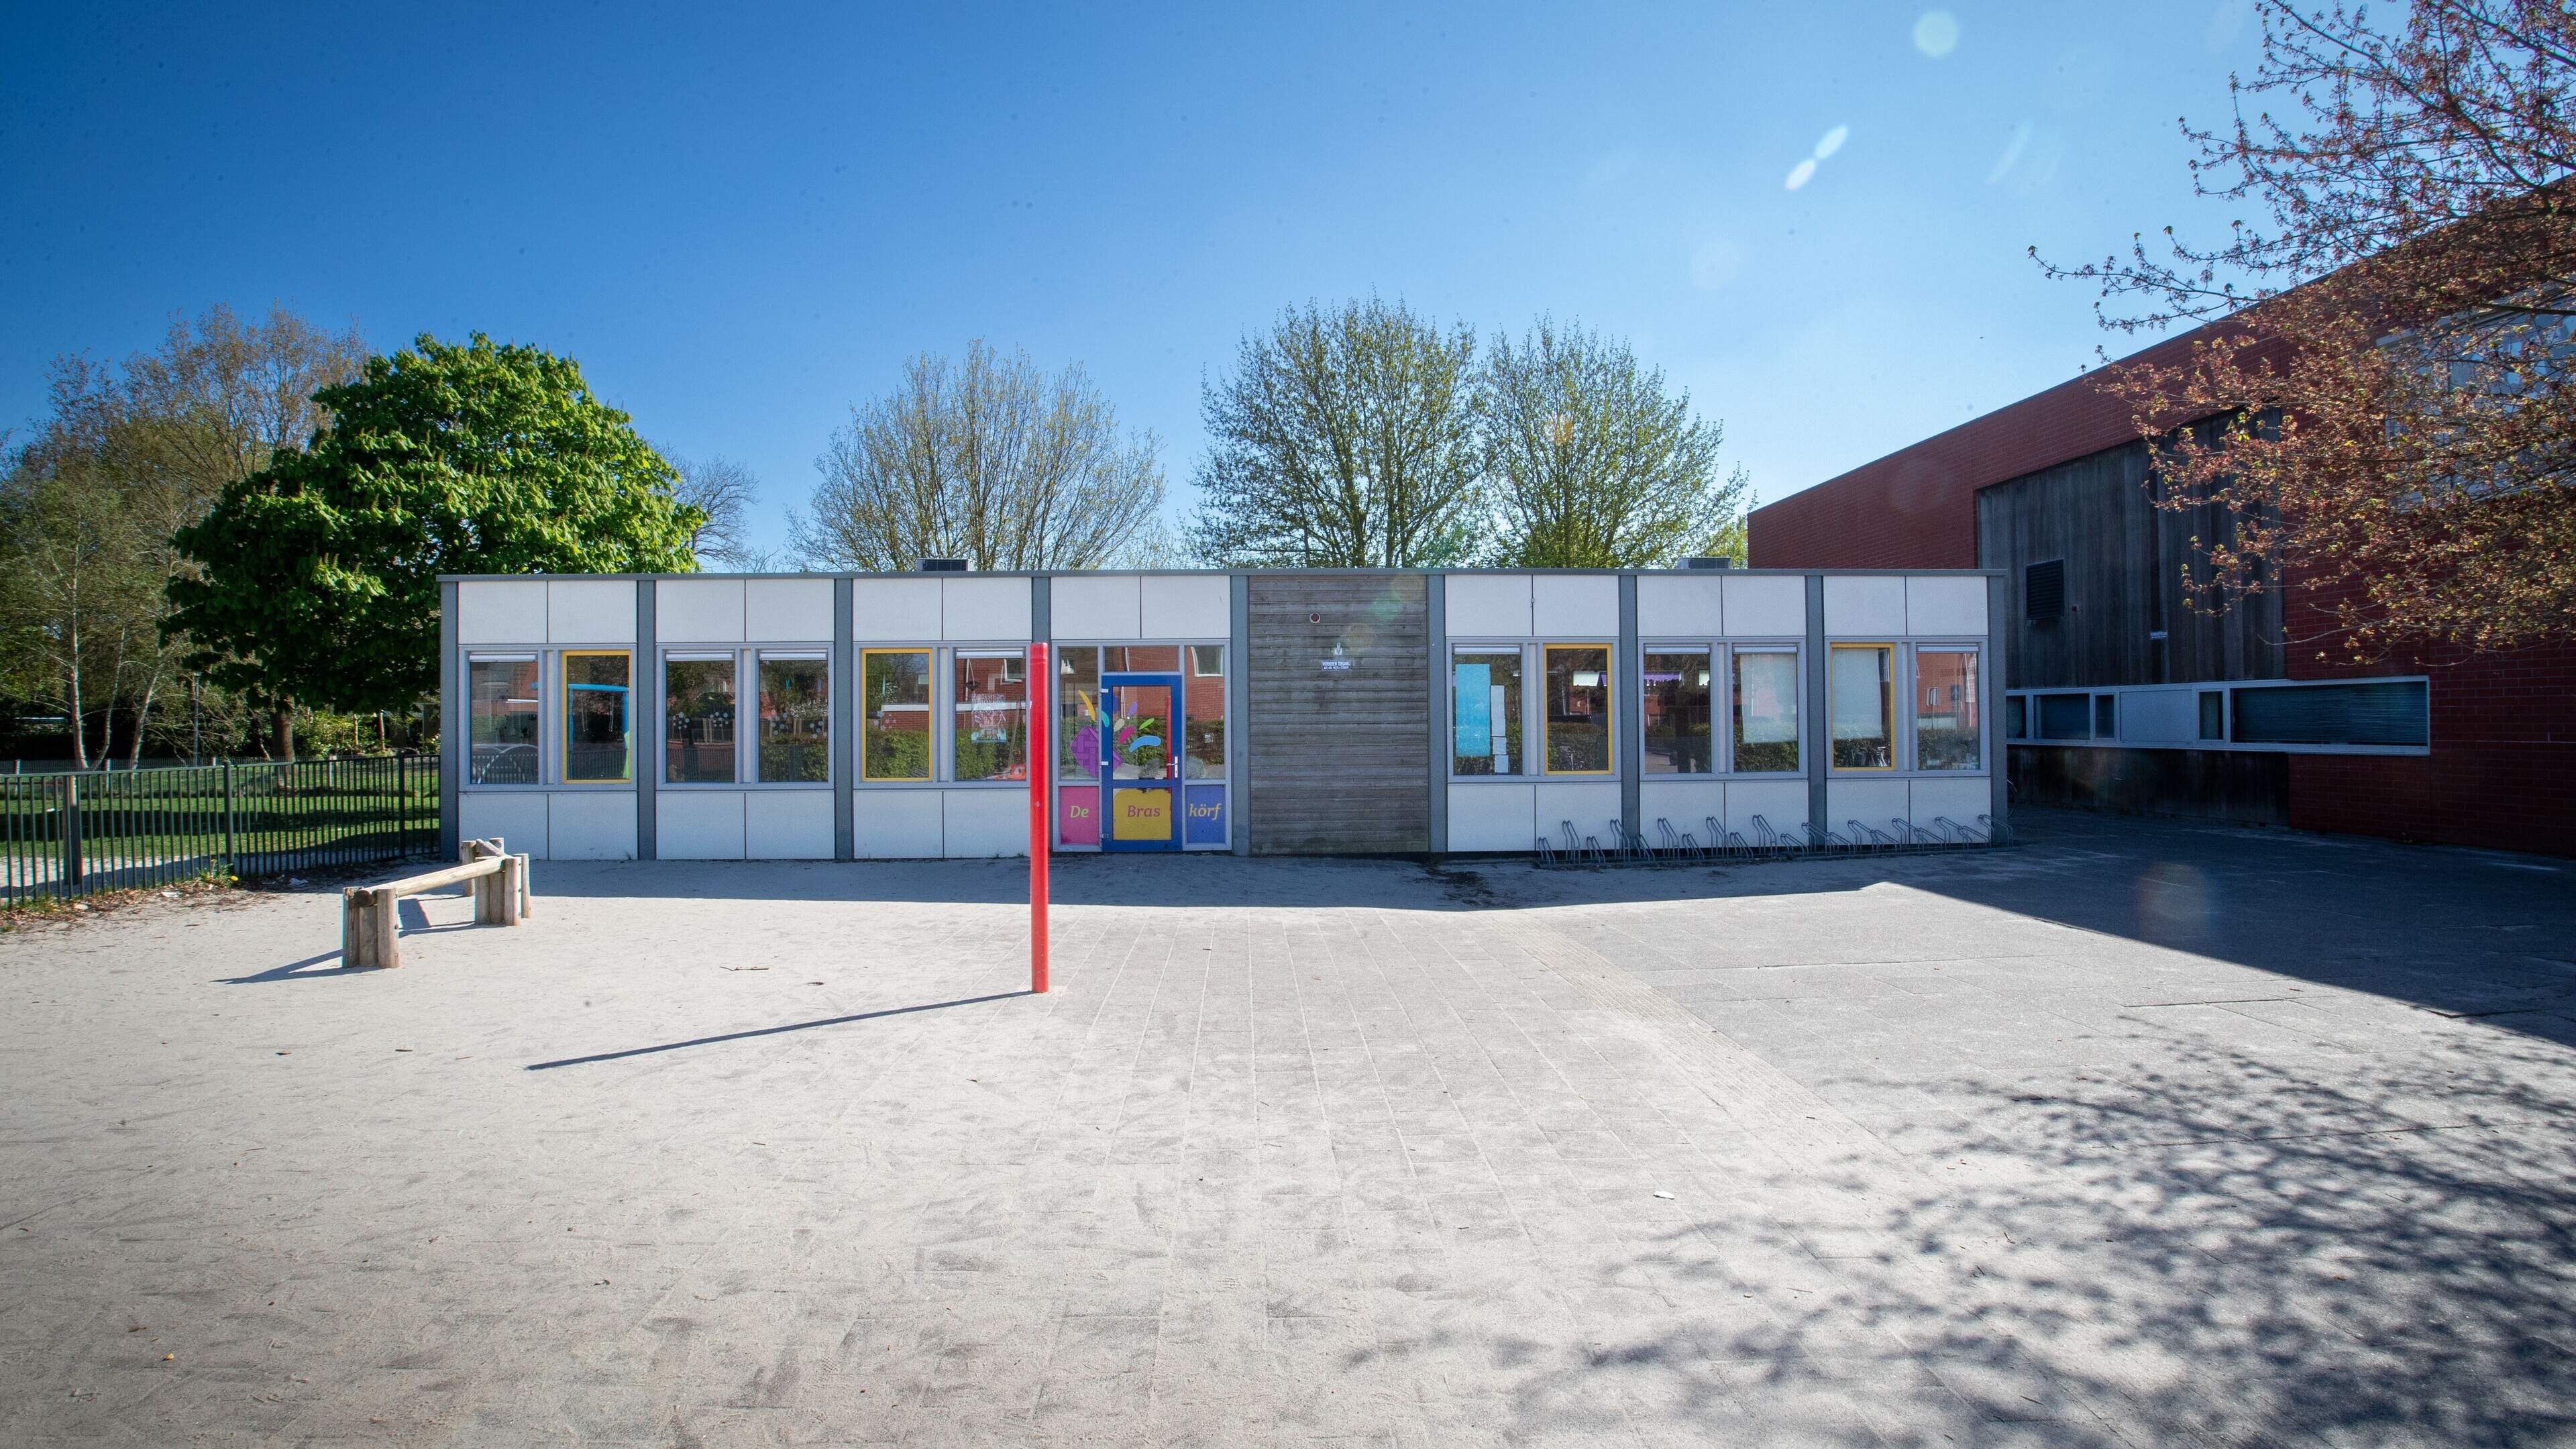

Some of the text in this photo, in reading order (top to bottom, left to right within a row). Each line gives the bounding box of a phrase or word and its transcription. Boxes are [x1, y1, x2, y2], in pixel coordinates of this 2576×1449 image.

[1070, 803, 1222, 820] De Bras körf
